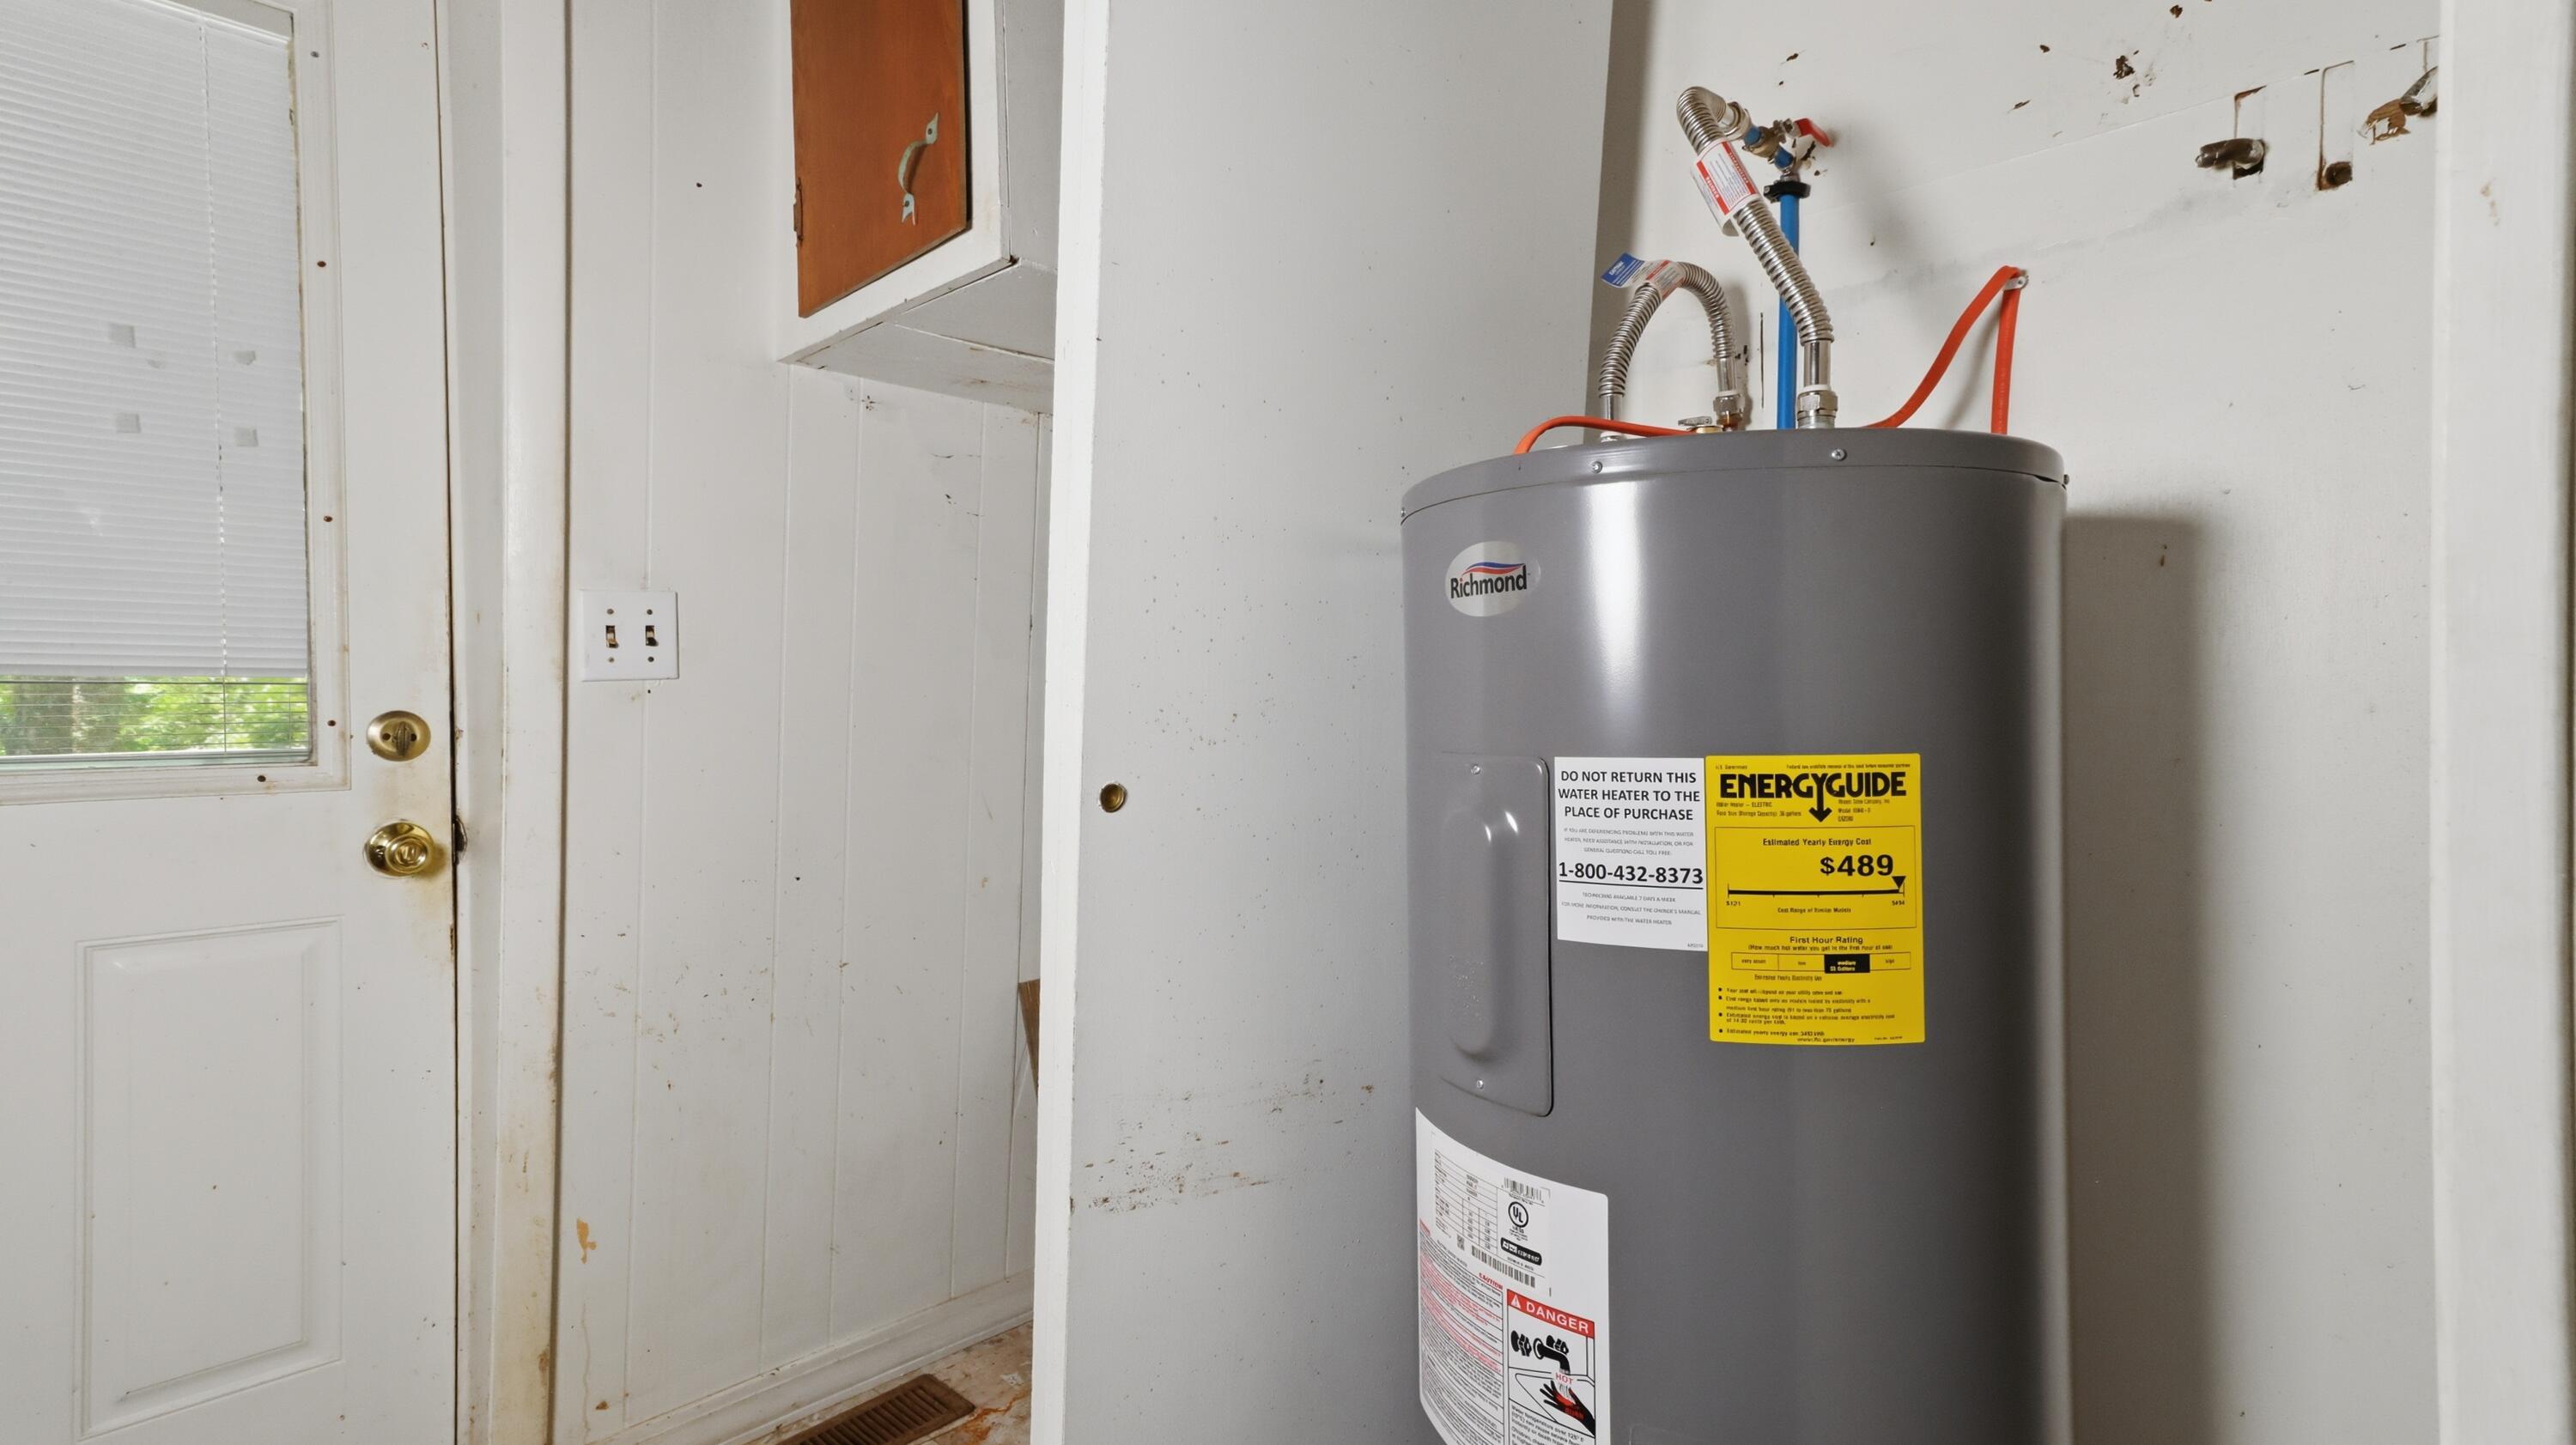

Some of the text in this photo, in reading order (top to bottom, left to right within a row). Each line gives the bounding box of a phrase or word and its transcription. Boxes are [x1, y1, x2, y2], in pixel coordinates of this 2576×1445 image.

[1450, 565, 1527, 598] Richmond
[1561, 771, 1697, 783] DO NOT RETURN THIS
[1720, 772, 1906, 800] ENERGYGUIDE
[1558, 789, 1700, 802] WATER HEATER TO THE
[1564, 806, 1693, 820] PLACE OF PURCHASE
[1802, 838, 1826, 847] Yearly
[1828, 838, 1854, 847] Energy
[1559, 862, 1704, 884] 1-800-432-8373
[1820, 854, 1894, 877] $489
[1836, 936, 1863, 944] Rating
[1513, 1205, 1523, 1223] UL
[1527, 1302, 1589, 1334] DANGER
[1556, 1373, 1574, 1384] HOT
